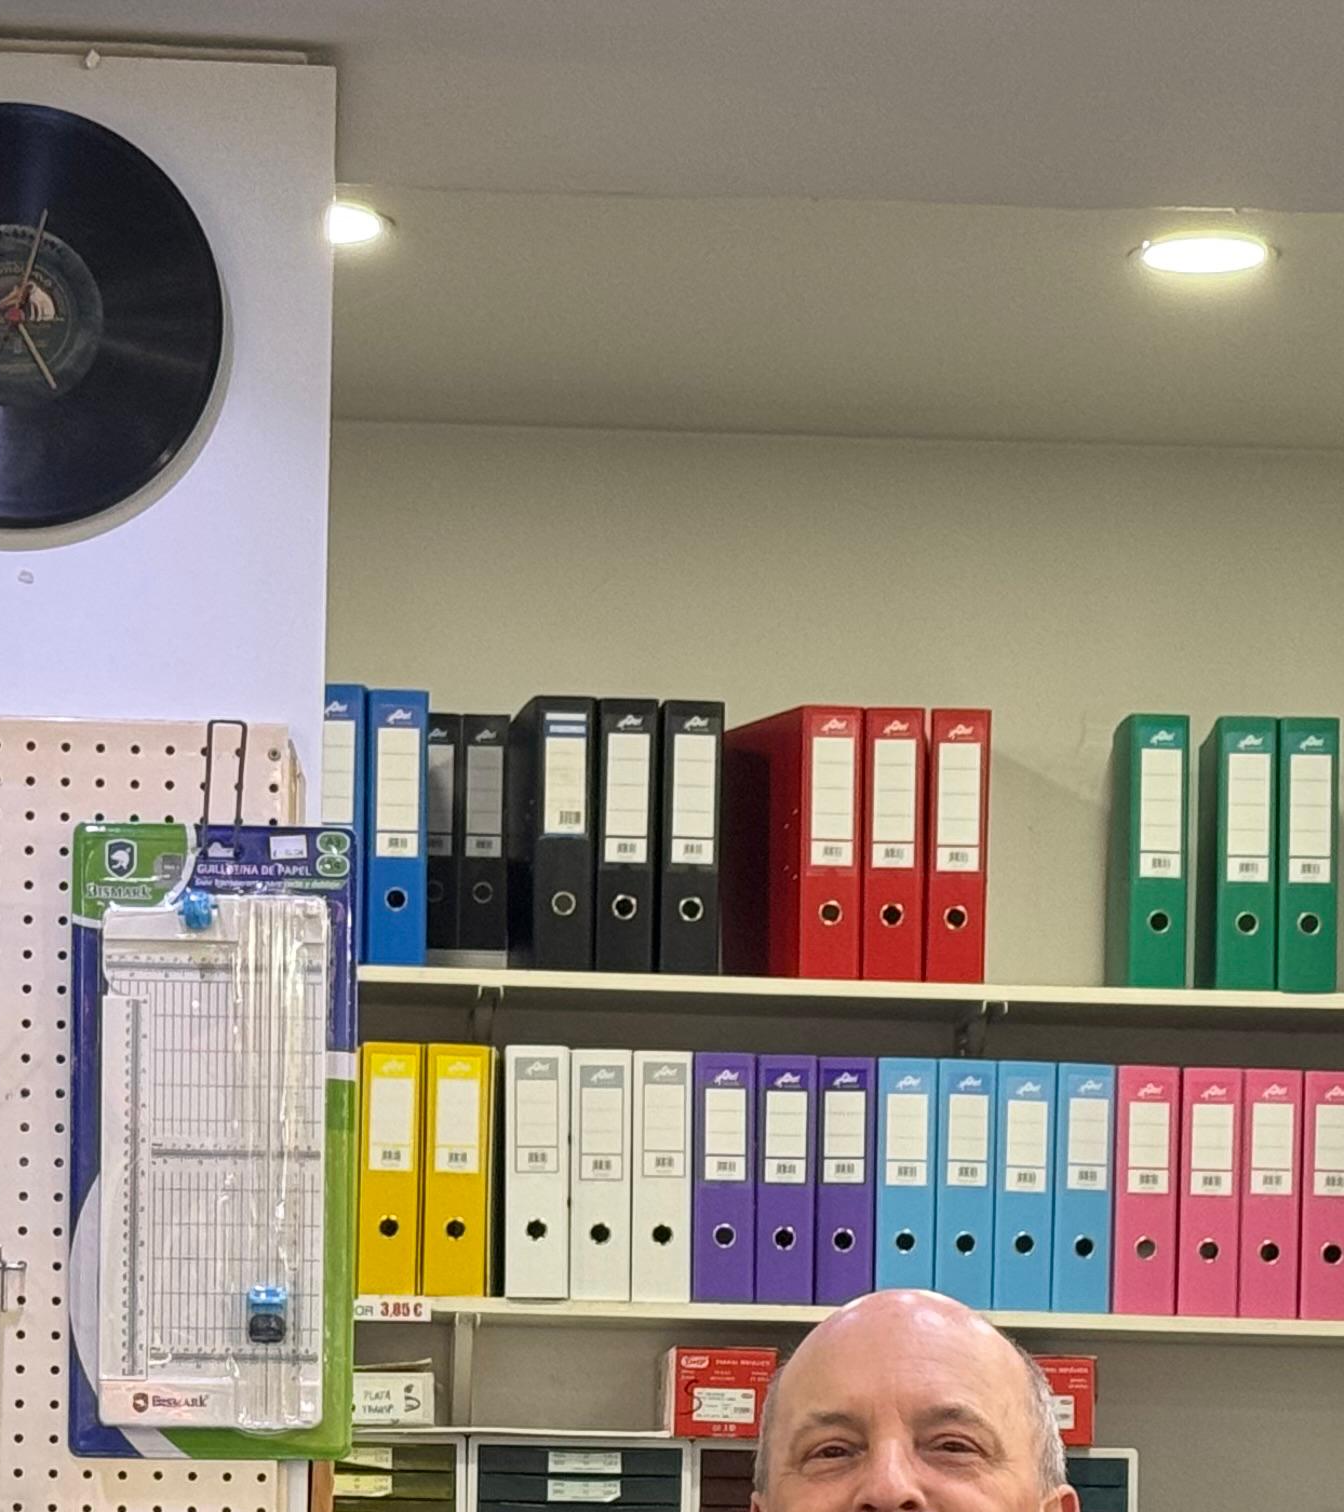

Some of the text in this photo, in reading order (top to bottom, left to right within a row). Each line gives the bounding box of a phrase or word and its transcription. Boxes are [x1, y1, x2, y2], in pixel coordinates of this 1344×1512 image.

[261, 865, 274, 875] DE
[277, 864, 312, 876] PAPEL
[86, 883, 152, 899] BISMARK
